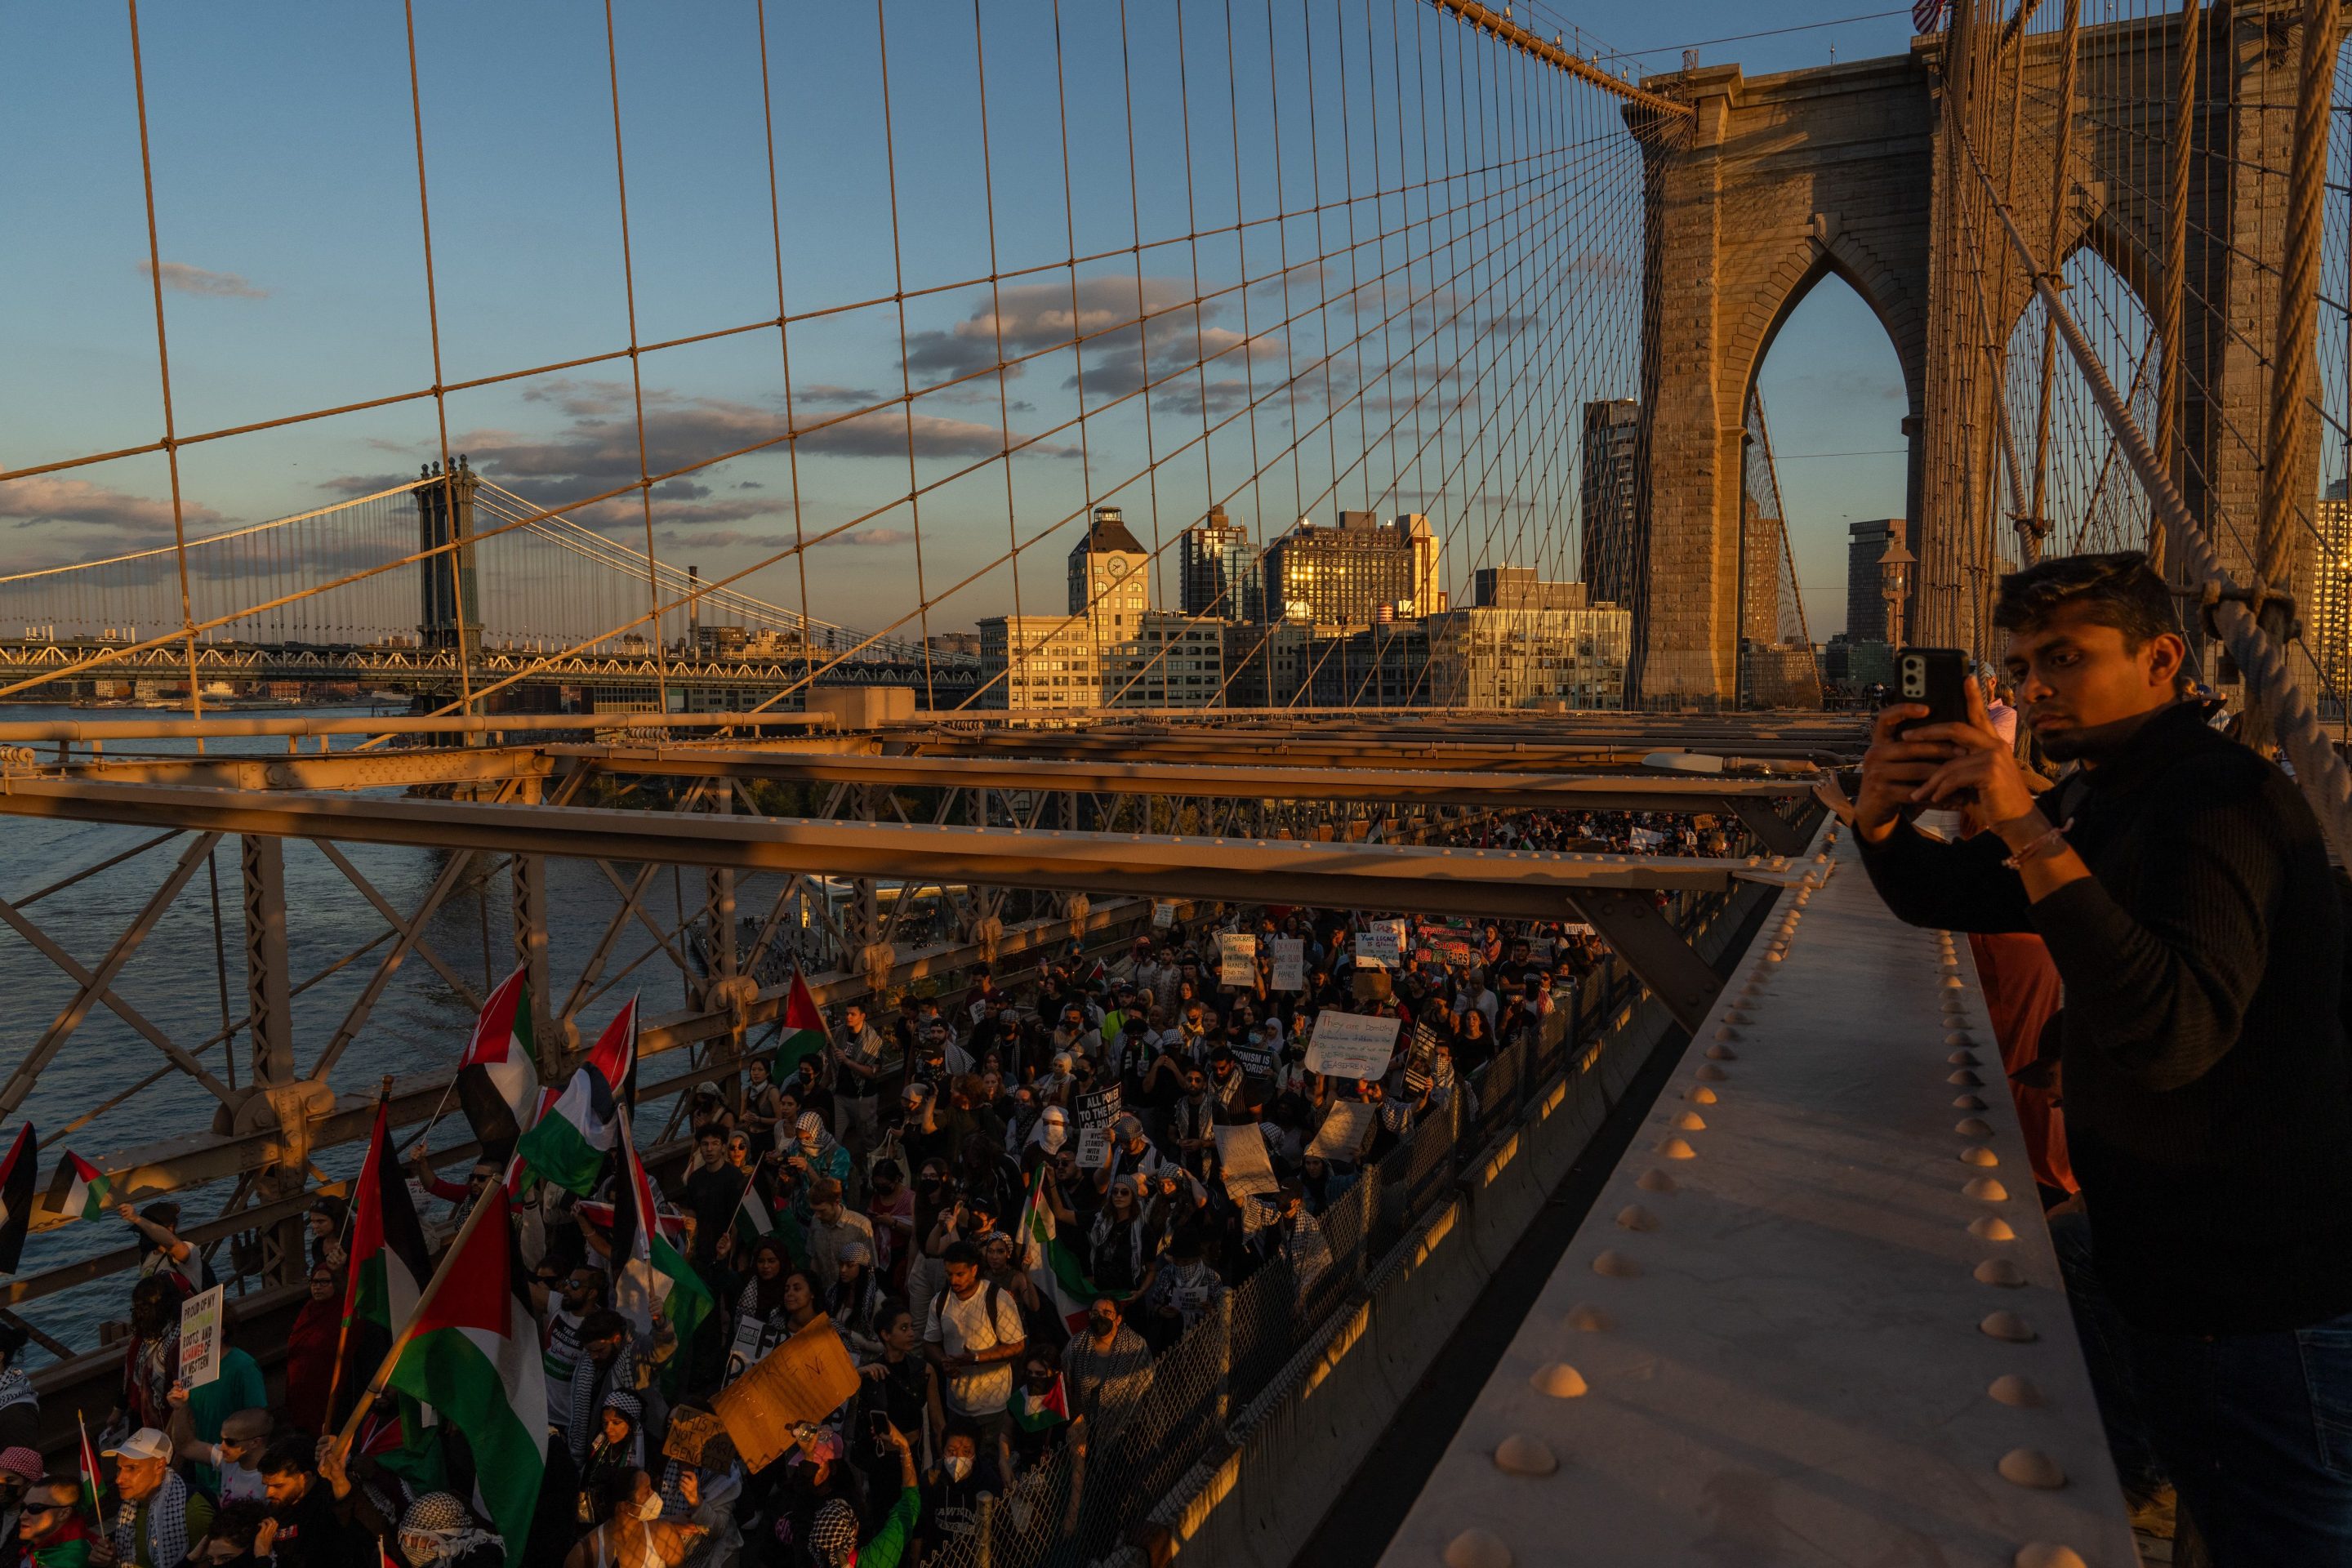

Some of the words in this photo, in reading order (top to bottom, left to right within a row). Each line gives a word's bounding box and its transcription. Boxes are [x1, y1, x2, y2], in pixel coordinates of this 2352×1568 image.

[1500, 584, 1514, 594] 60
[1520, 585, 1556, 595] WATER
[1223, 935, 1255, 943] DEMOCRATS
[1419, 925, 1470, 938] APARTHEID
[1237, 944, 1255, 952] BLOOD
[1434, 941, 1469, 951] STATE
[1224, 953, 1232, 961] ON
[1414, 948, 1432, 962] FOR
[1443, 951, 1468, 964] YEARS
[1321, 1015, 1343, 1034] They
[1366, 1020, 1393, 1035] bombing
[1263, 1054, 1271, 1066] IS
[1087, 1096, 1102, 1109] ALL
[1102, 1088, 1119, 1105] POWER
[1080, 1111, 1091, 1122] TO
[1092, 1105, 1107, 1120] THE
[184, 1301, 200, 1321] PROUD
[200, 1298, 207, 1312] OF
[207, 1293, 216, 1308] MY
[182, 1329, 199, 1350] ROOTS
[201, 1325, 212, 1342] AND
[552, 1327, 581, 1348] PALESTINE
[182, 1342, 204, 1363] ASHAMED
[204, 1339, 212, 1353] OF
[180, 1364, 188, 1377] MY
[188, 1352, 209, 1374] WESTERN
[670, 1426, 696, 1446] NOT
